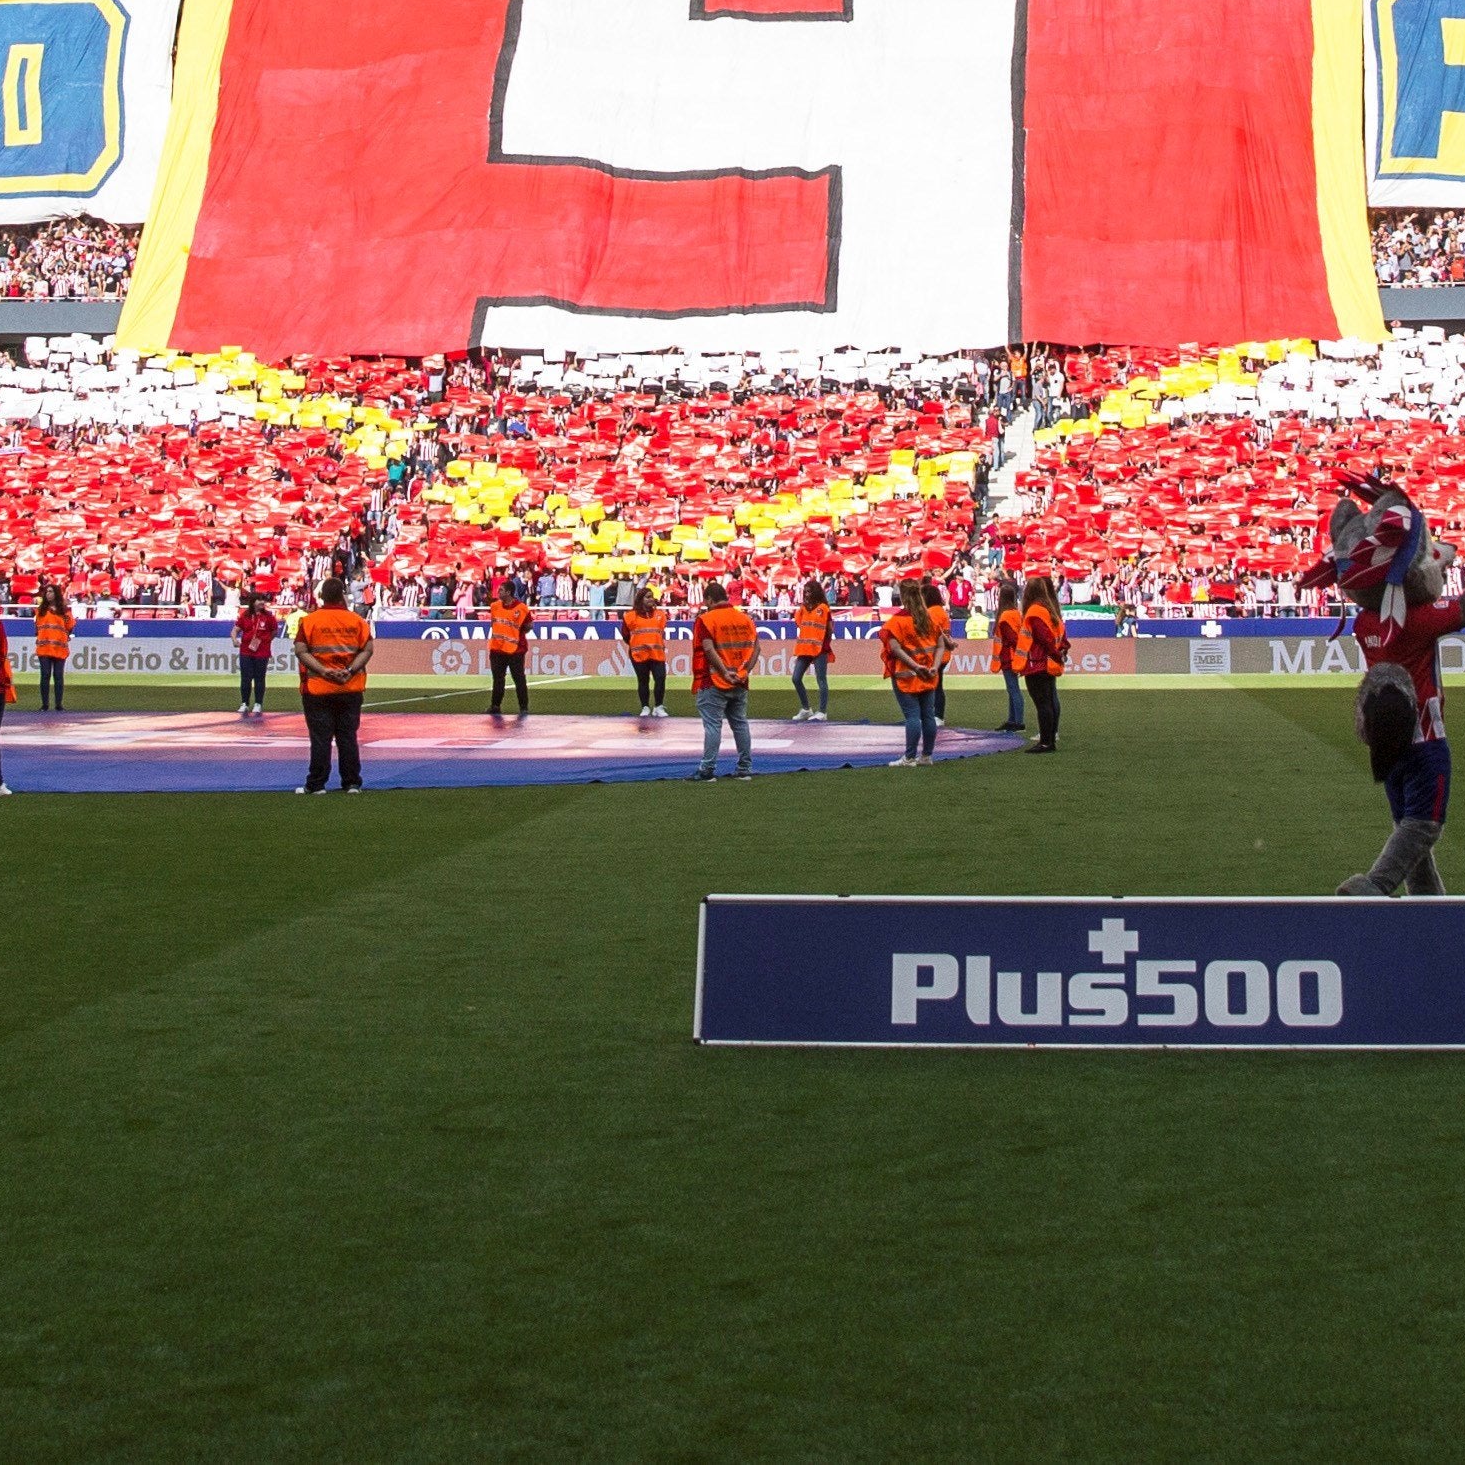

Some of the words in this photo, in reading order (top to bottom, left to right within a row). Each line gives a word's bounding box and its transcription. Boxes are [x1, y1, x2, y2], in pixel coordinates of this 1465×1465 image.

[73, 646, 162, 672] diseño
[169, 647, 189, 671] &
[891, 944, 1343, 1027] Plus500
